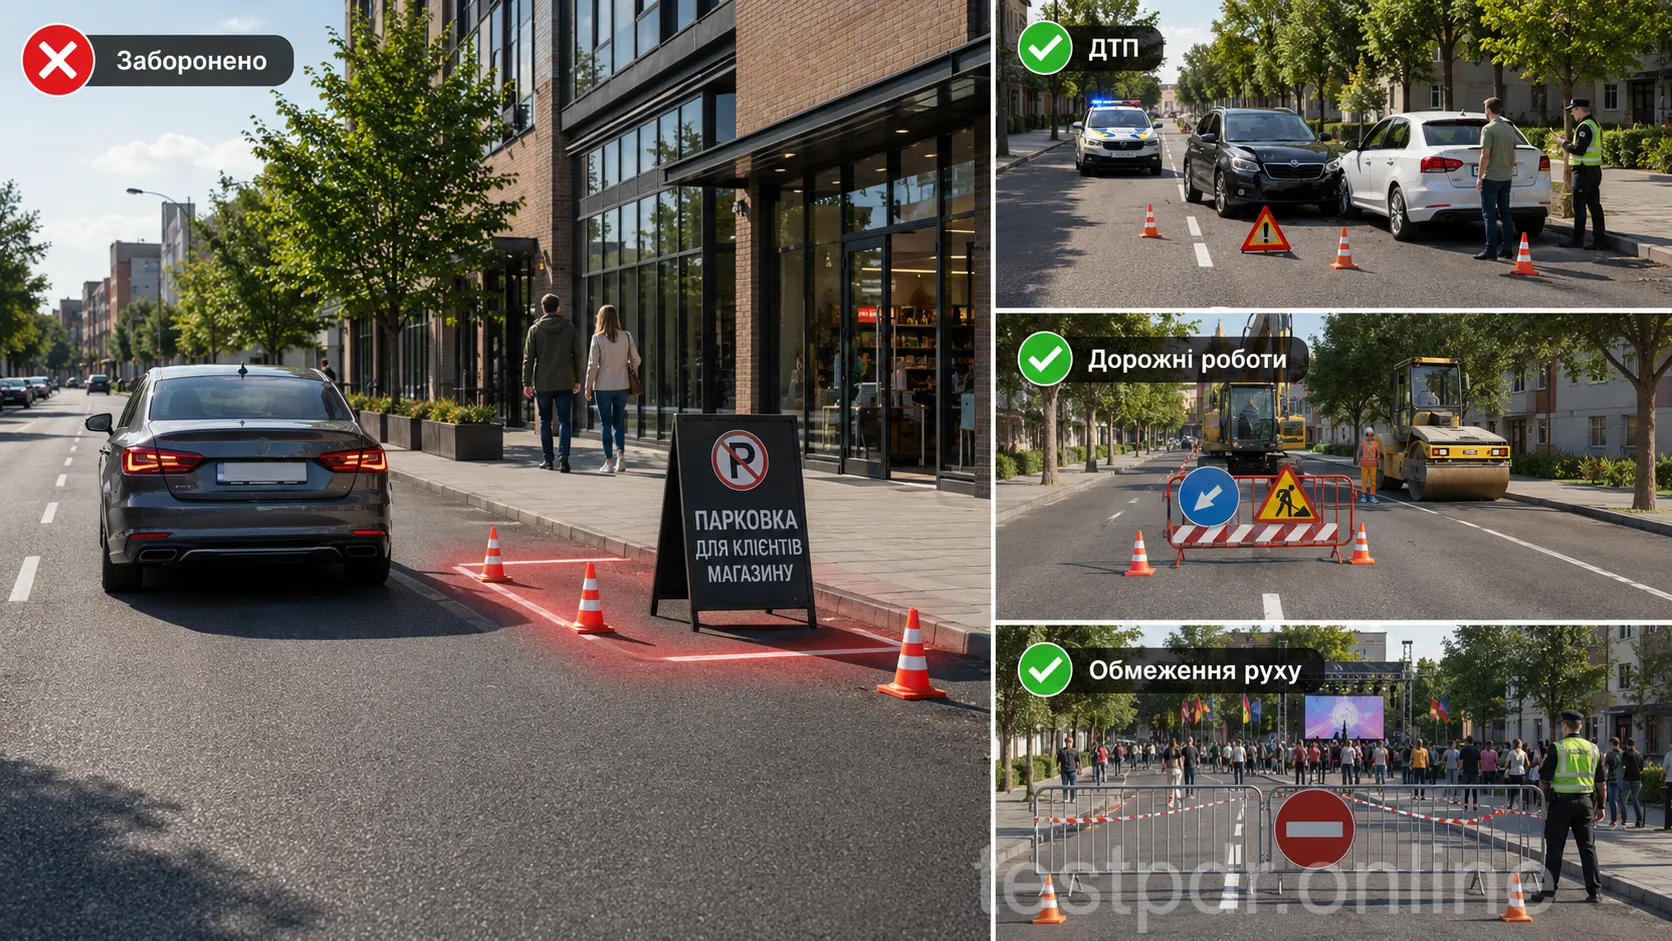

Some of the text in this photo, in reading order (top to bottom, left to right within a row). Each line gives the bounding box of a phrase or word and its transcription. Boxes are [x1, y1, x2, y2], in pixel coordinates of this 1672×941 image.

[695, 509, 799, 531] ПАРКОВКА
[695, 538, 803, 560] ДЛЯ КЛІЄНТІВ
[707, 563, 794, 583] МАГАЗИНУ
